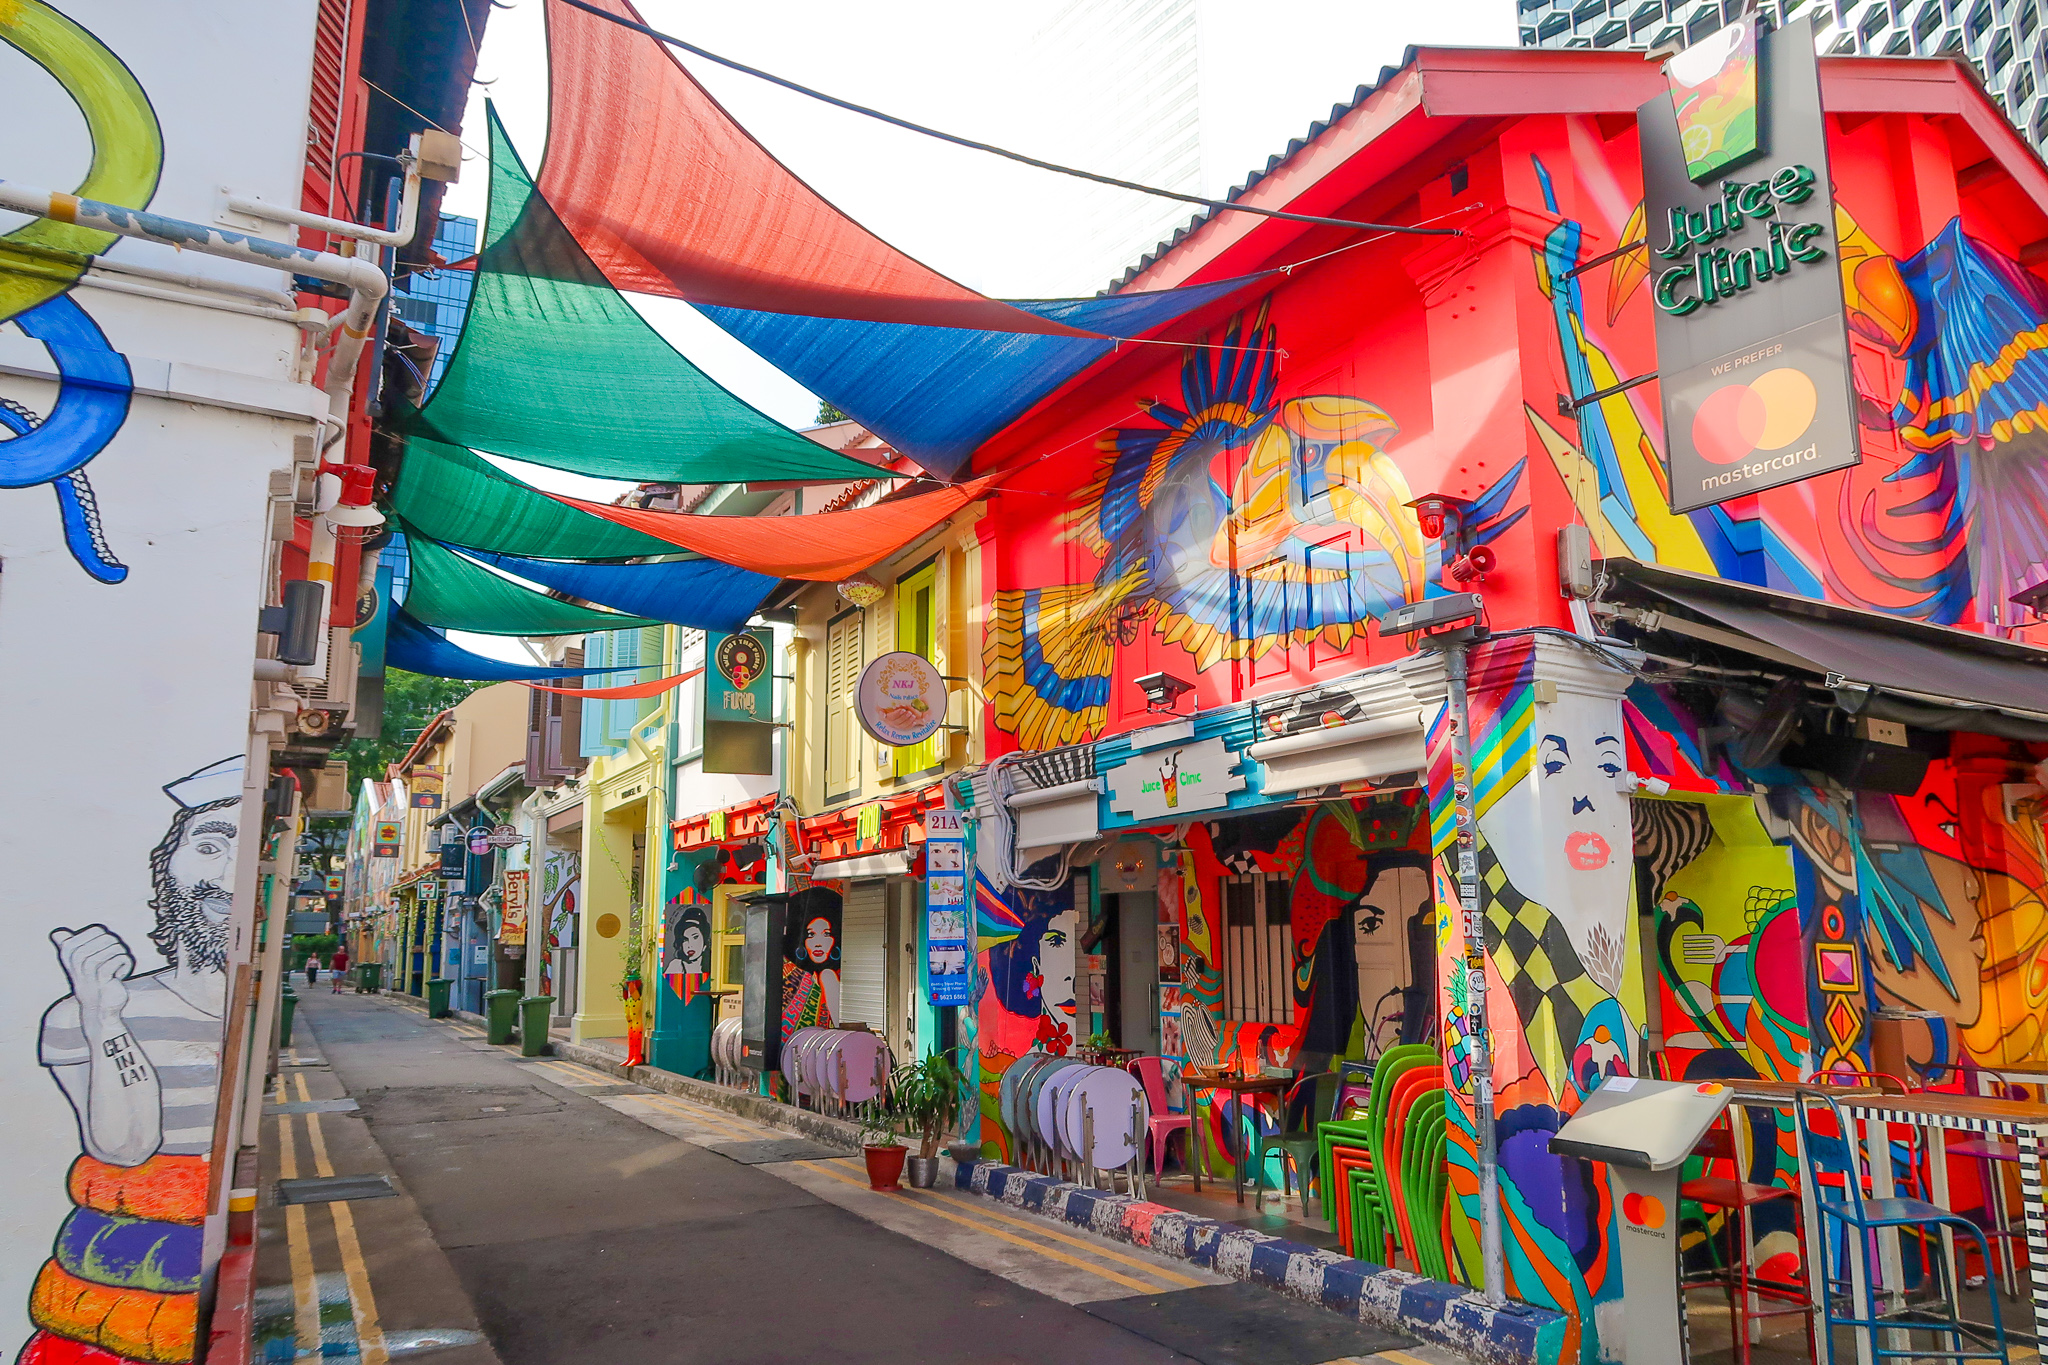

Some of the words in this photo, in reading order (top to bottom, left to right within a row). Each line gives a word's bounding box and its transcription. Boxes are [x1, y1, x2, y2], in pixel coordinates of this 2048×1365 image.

[1655, 165, 1815, 259] Juice
[1654, 221, 1828, 315] Clinic
[1711, 360, 1732, 377] WE
[1735, 343, 1784, 369] PREFER
[1701, 443, 1818, 491] mastercard
[724, 640, 737, 654] GOT
[738, 639, 754, 649] THE
[722, 654, 730, 668] WE
[892, 680, 915, 689] NKJ
[875, 721, 890, 736] Relax
[890, 731, 911, 740] Renew
[911, 719, 937, 739] Revitalize
[1142, 781, 1160, 793] Juice
[1181, 772, 1201, 786] Clinic
[931, 815, 960, 830] 21A
[507, 872, 522, 919] Beryl's
[103, 1032, 130, 1057] GET
[115, 1052, 135, 1070] IN
[120, 1065, 148, 1087] LA!
[1626, 1225, 1666, 1239] mastercard
